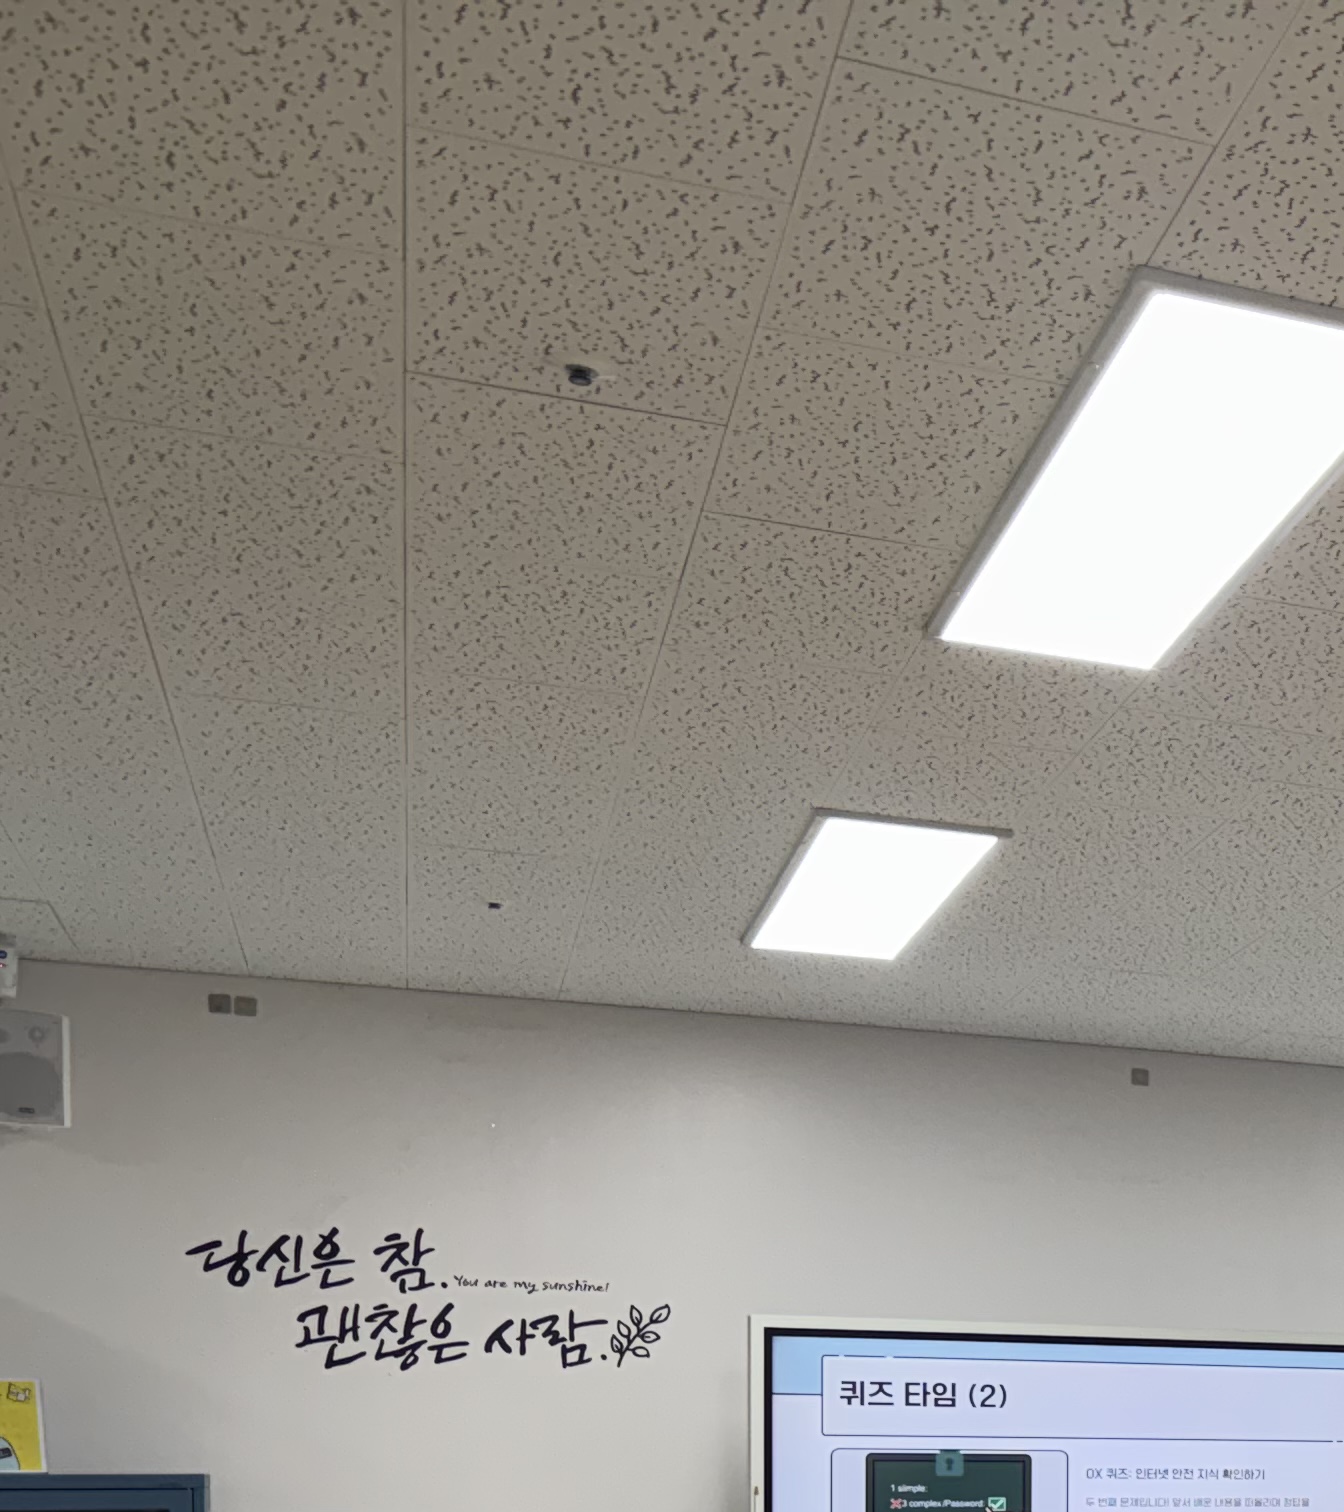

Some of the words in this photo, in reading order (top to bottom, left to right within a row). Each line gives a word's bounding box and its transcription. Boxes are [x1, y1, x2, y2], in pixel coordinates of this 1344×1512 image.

[185, 1227, 355, 1289] 당신은
[453, 1274, 479, 1288] You
[484, 1279, 508, 1290] are
[513, 1280, 538, 1294] my
[295, 1302, 470, 1371] 괜찮은
[840, 1380, 894, 1406] 퀴즈
[904, 1382, 957, 1408] 타임
[968, 1383, 1007, 1409] (2)
[1135, 1467, 1169, 1480] 인터넷
[1172, 1468, 1194, 1480] 안전
[1197, 1468, 1219, 1480] 지식
[1222, 1468, 1266, 1480] 확인하기
